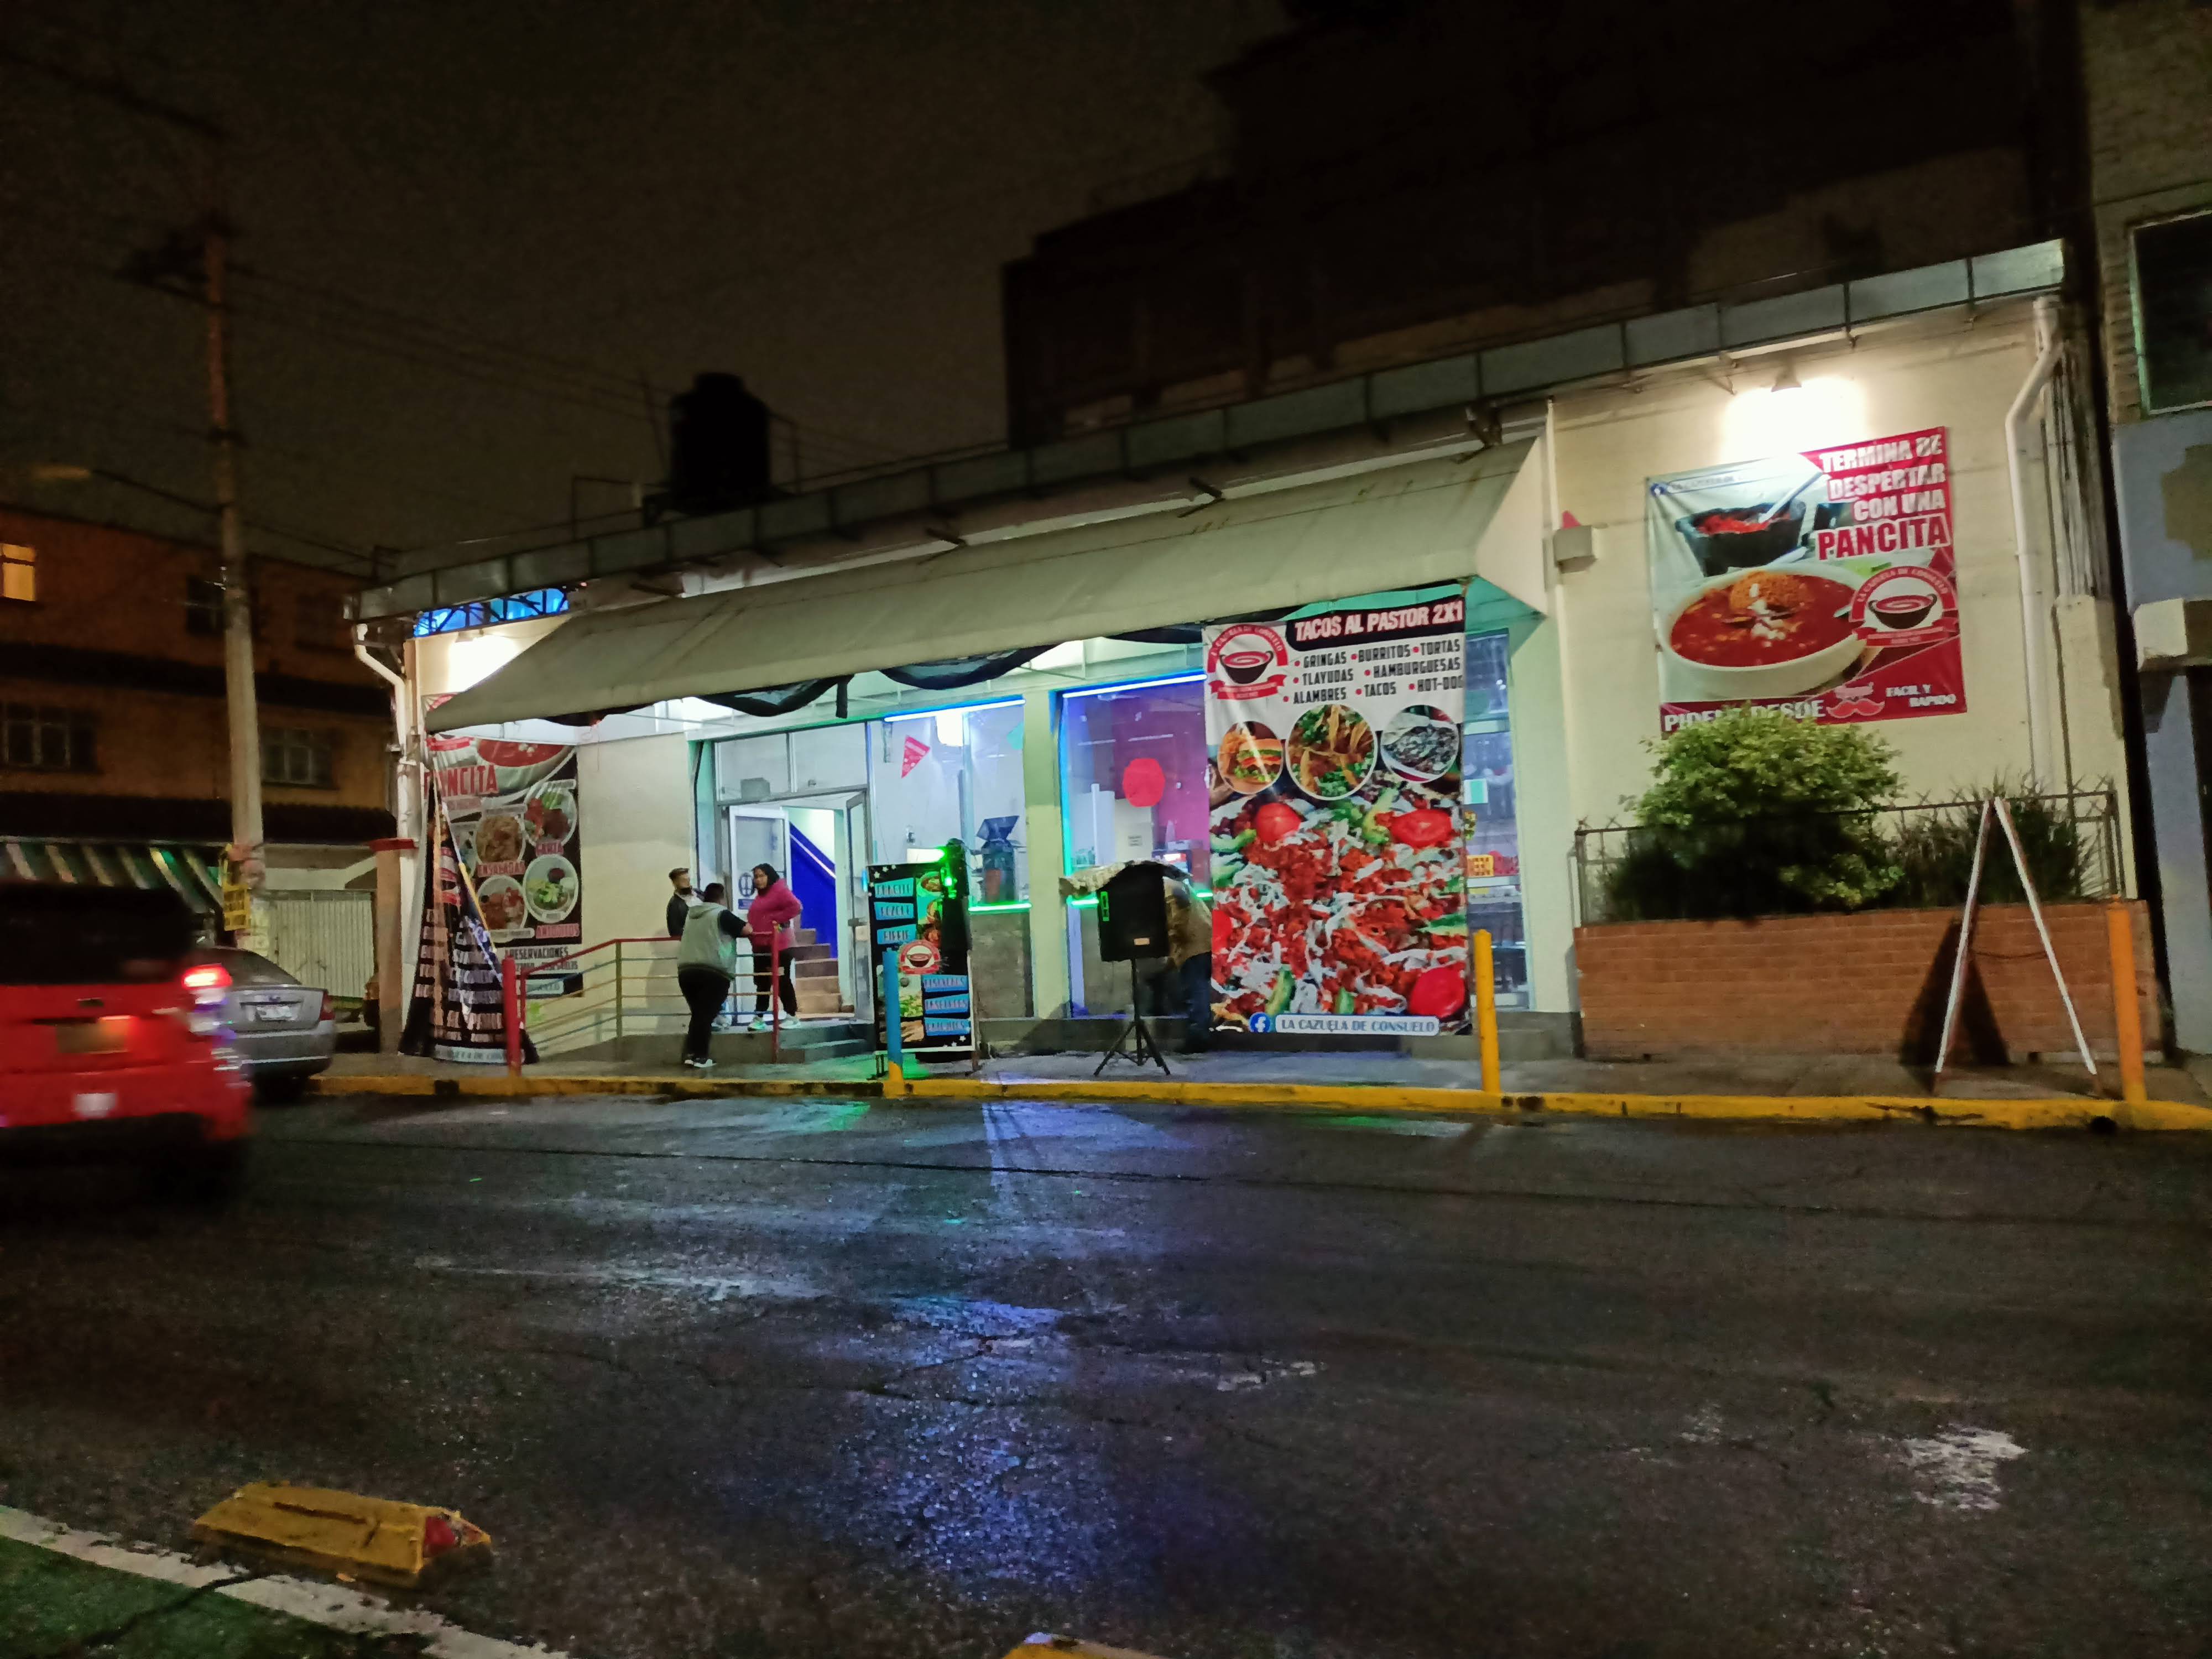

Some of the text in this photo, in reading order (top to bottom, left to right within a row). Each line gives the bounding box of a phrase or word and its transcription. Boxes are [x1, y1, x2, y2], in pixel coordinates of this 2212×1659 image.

[1819, 434, 1943, 473] TERMINA DE
[1829, 463, 1946, 499] DESPERTAR
[1854, 489, 1945, 521] CON UNA
[1818, 517, 1947, 560] PANCITA
[1295, 601, 1463, 641] TACOS AL PASTOR 2X1
[1303, 639, 1460, 668] GRINGAS BURRITOS TORTAS
[1302, 657, 1460, 685] TLAYUDAS HAMBURGUESAS
[1293, 687, 1346, 704] ALAMBRES
[1364, 682, 1396, 697] TACOS
[1282, 1020, 1435, 1032] LA CAZUELA DE CONSUELO
